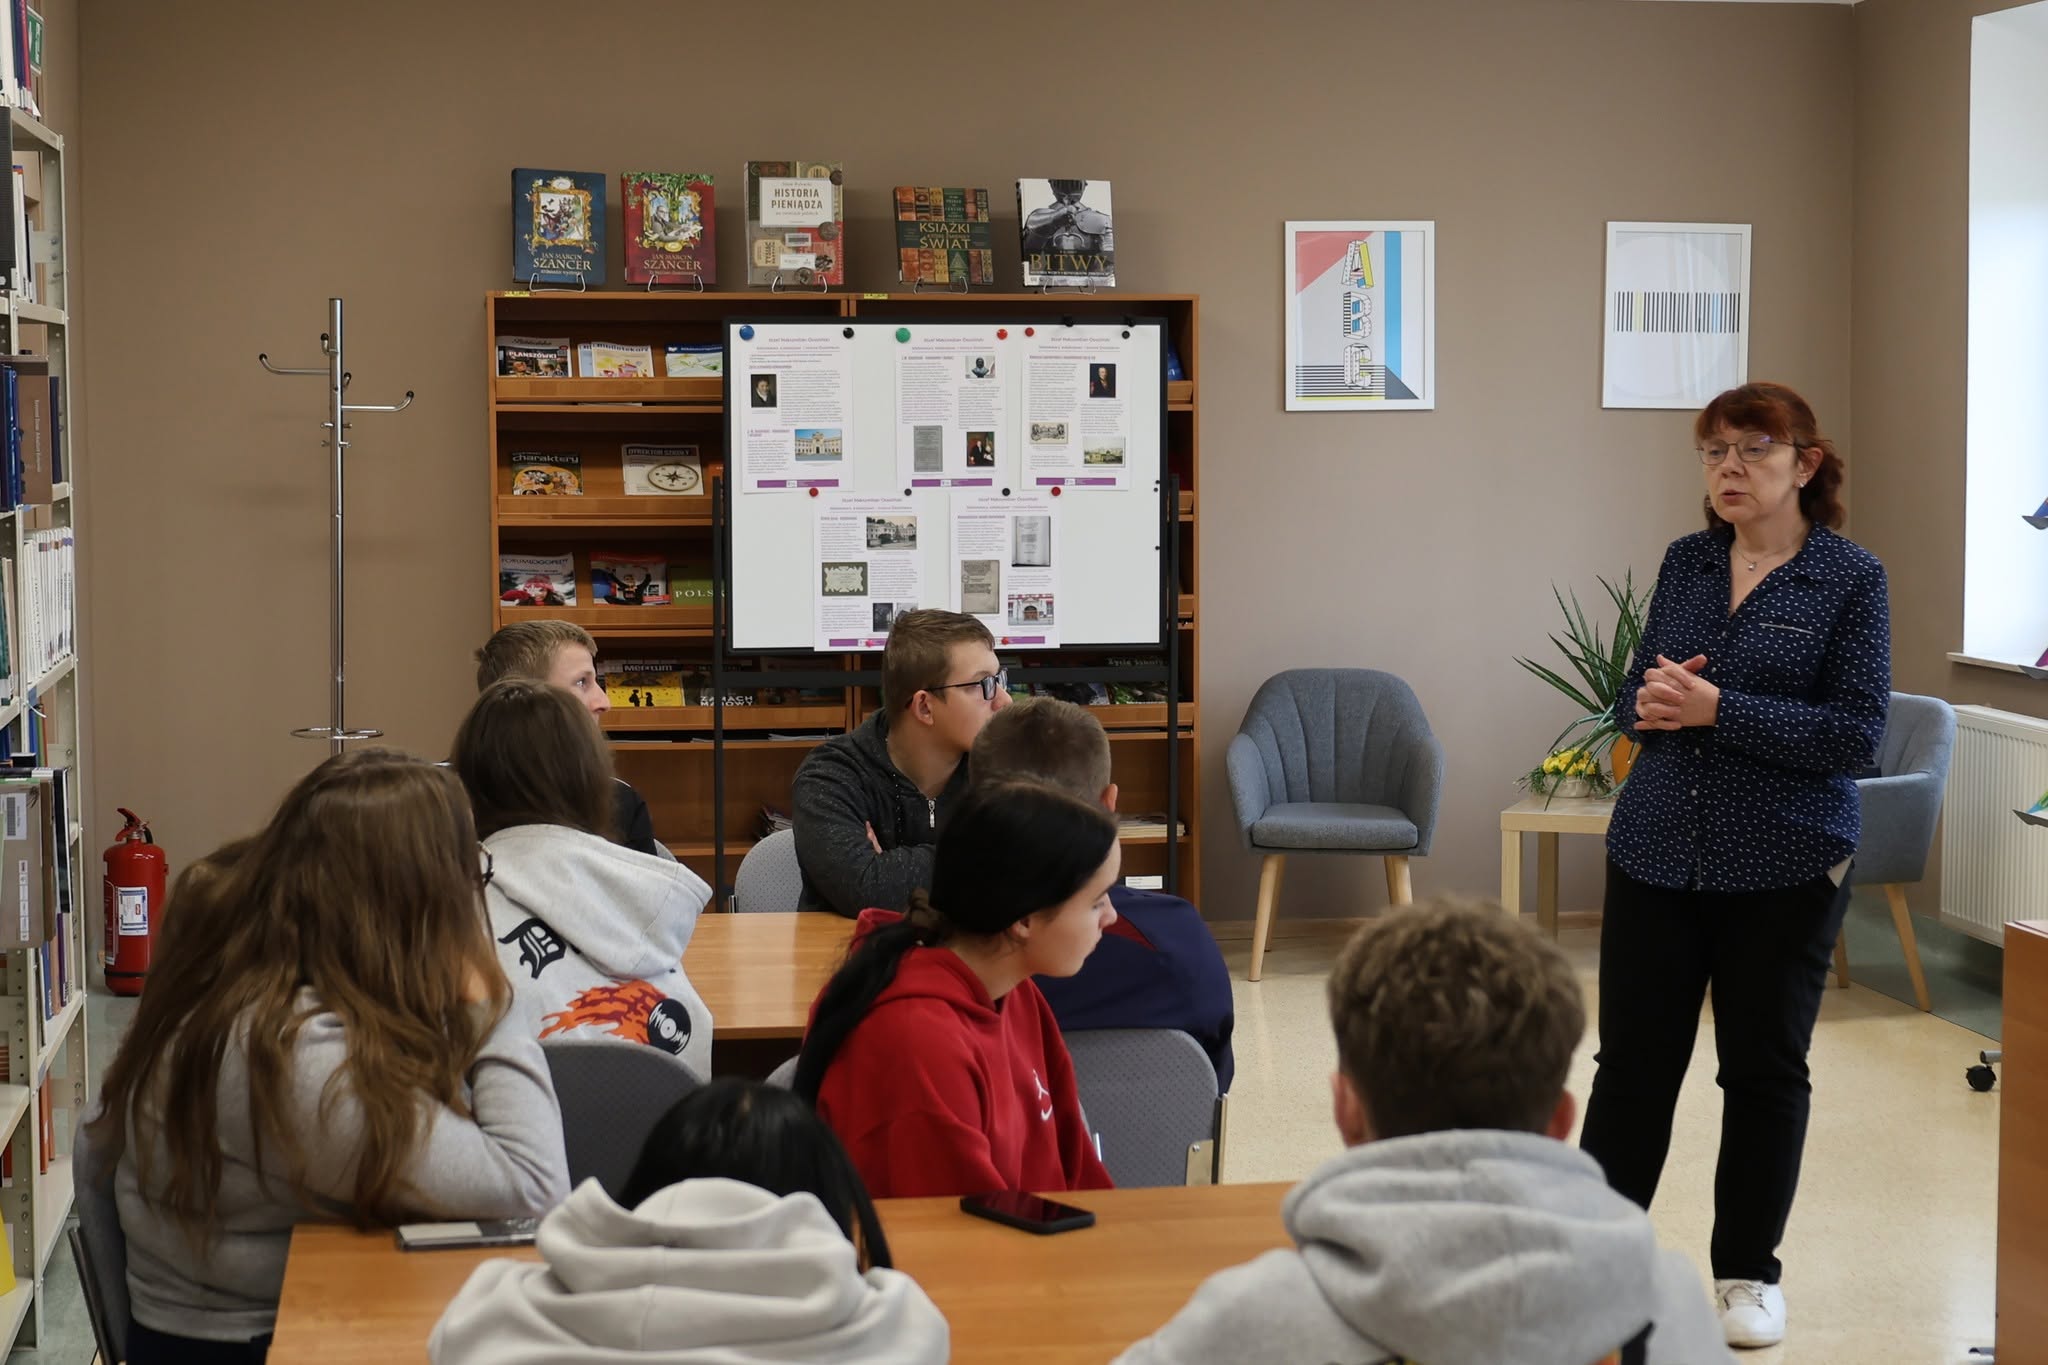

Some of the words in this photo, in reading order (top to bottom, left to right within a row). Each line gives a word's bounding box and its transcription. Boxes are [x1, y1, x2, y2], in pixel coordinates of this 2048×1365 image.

[774, 188, 820, 198] HISTORIA
[771, 200, 823, 211] PIENIĄDZA
[919, 221, 971, 234] KSIĄŻKI
[919, 236, 972, 249] ŚWIAT
[541, 252, 554, 260] JAN
[554, 253, 582, 261] MARCIN
[1029, 253, 1108, 272] BITWY
[532, 257, 593, 272] SZANCER
[643, 258, 703, 271] SZANCER
[508, 350, 557, 359] PLANSZÓWKI
[512, 454, 579, 464] charaktery
